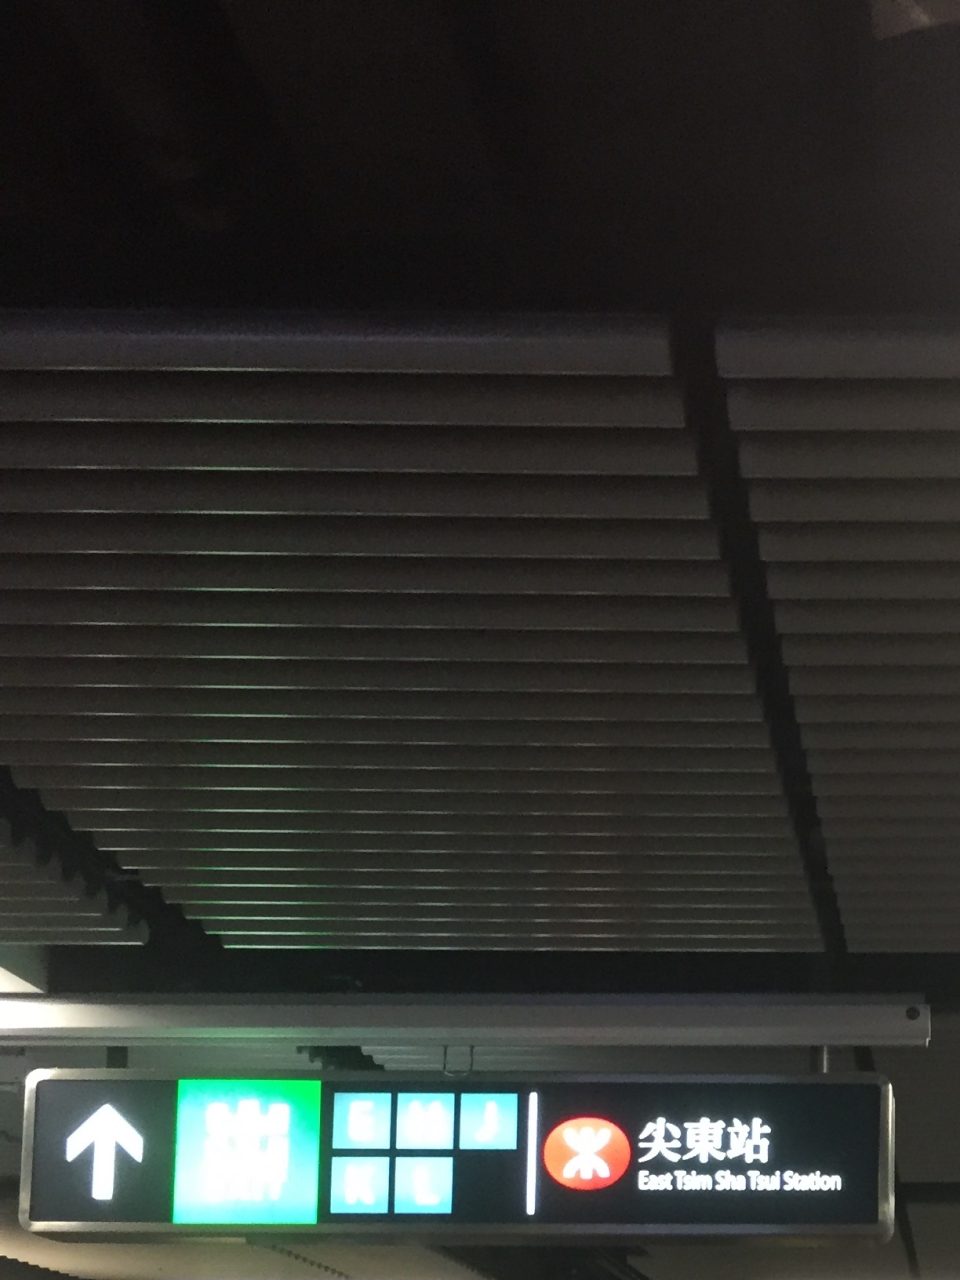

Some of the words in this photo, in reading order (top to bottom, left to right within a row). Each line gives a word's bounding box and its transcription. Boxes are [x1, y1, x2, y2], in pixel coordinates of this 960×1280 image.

[638, 1117, 771, 1163] 尖東站
[638, 1170, 673, 1190] East
[674, 1170, 713, 1190] Tsim
[715, 1170, 746, 1190] Sha
[747, 1170, 781, 1190] Tsui
[783, 1170, 842, 1190] Station
